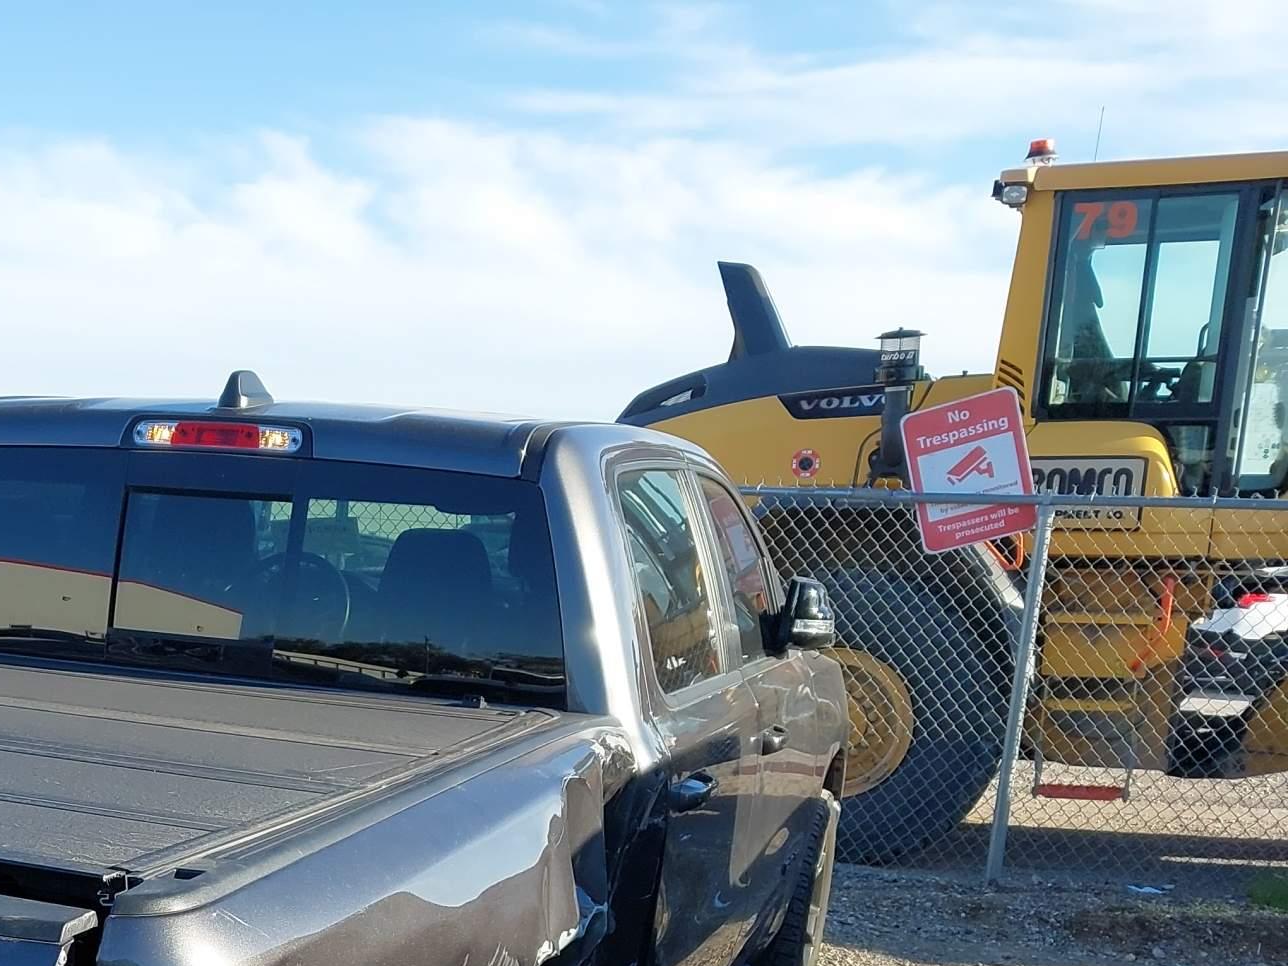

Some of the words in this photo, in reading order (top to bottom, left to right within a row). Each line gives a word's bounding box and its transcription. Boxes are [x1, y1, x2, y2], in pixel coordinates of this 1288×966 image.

[1074, 200, 1137, 240] 79
[799, 393, 887, 411] VOLV
[947, 410, 970, 424] No
[917, 416, 1009, 449] Trespassing
[938, 516, 991, 534] Trespassers
[992, 508, 1008, 522] will
[1009, 507, 1022, 517] be
[956, 521, 1007, 541] prosecuted
